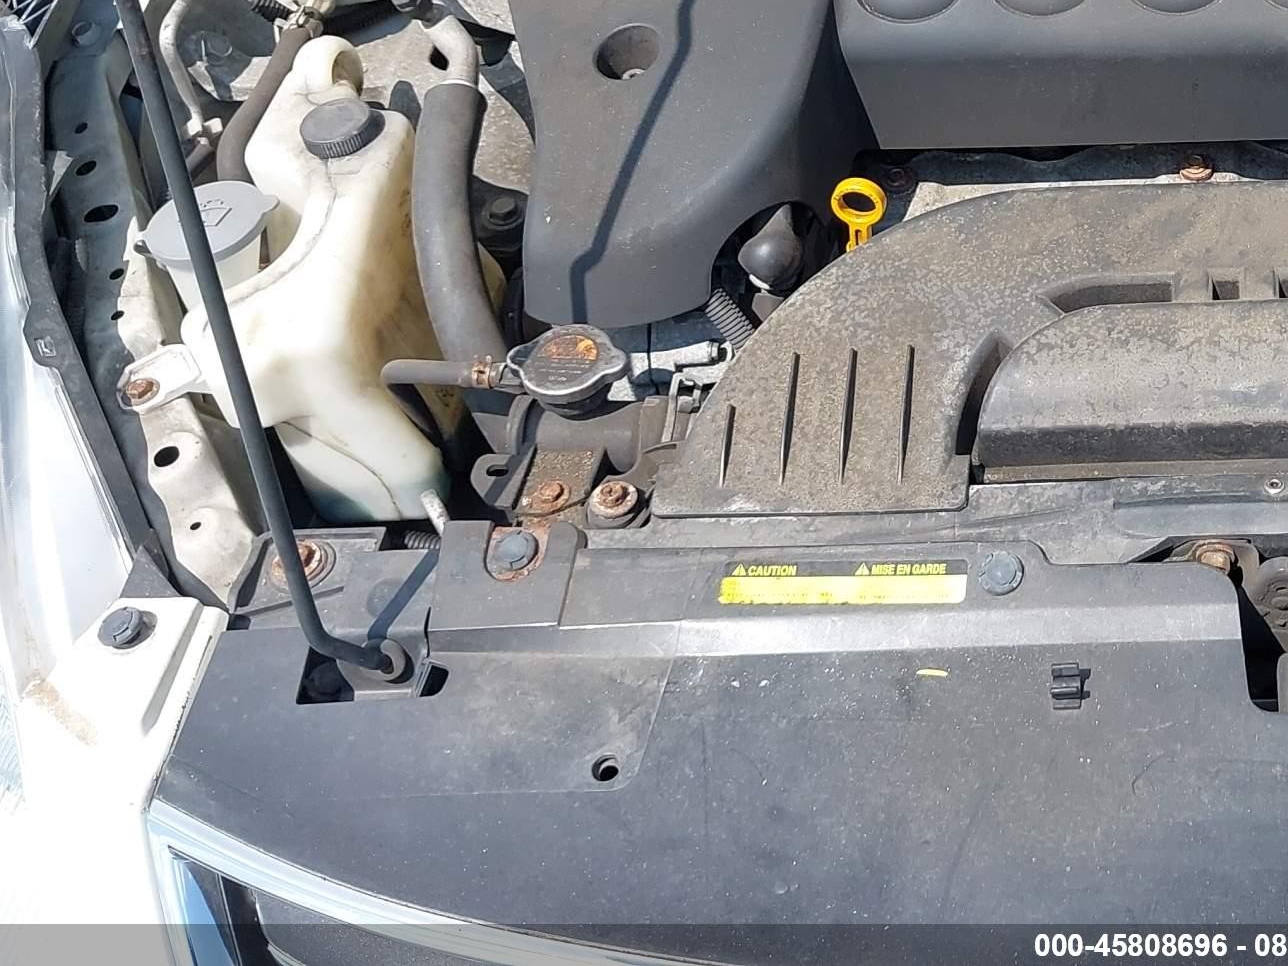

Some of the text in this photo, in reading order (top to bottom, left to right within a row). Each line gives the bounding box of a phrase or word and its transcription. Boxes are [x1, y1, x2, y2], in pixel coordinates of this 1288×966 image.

[748, 565, 797, 575] CAUTION
[872, 563, 946, 575] MISE EN GARDE
